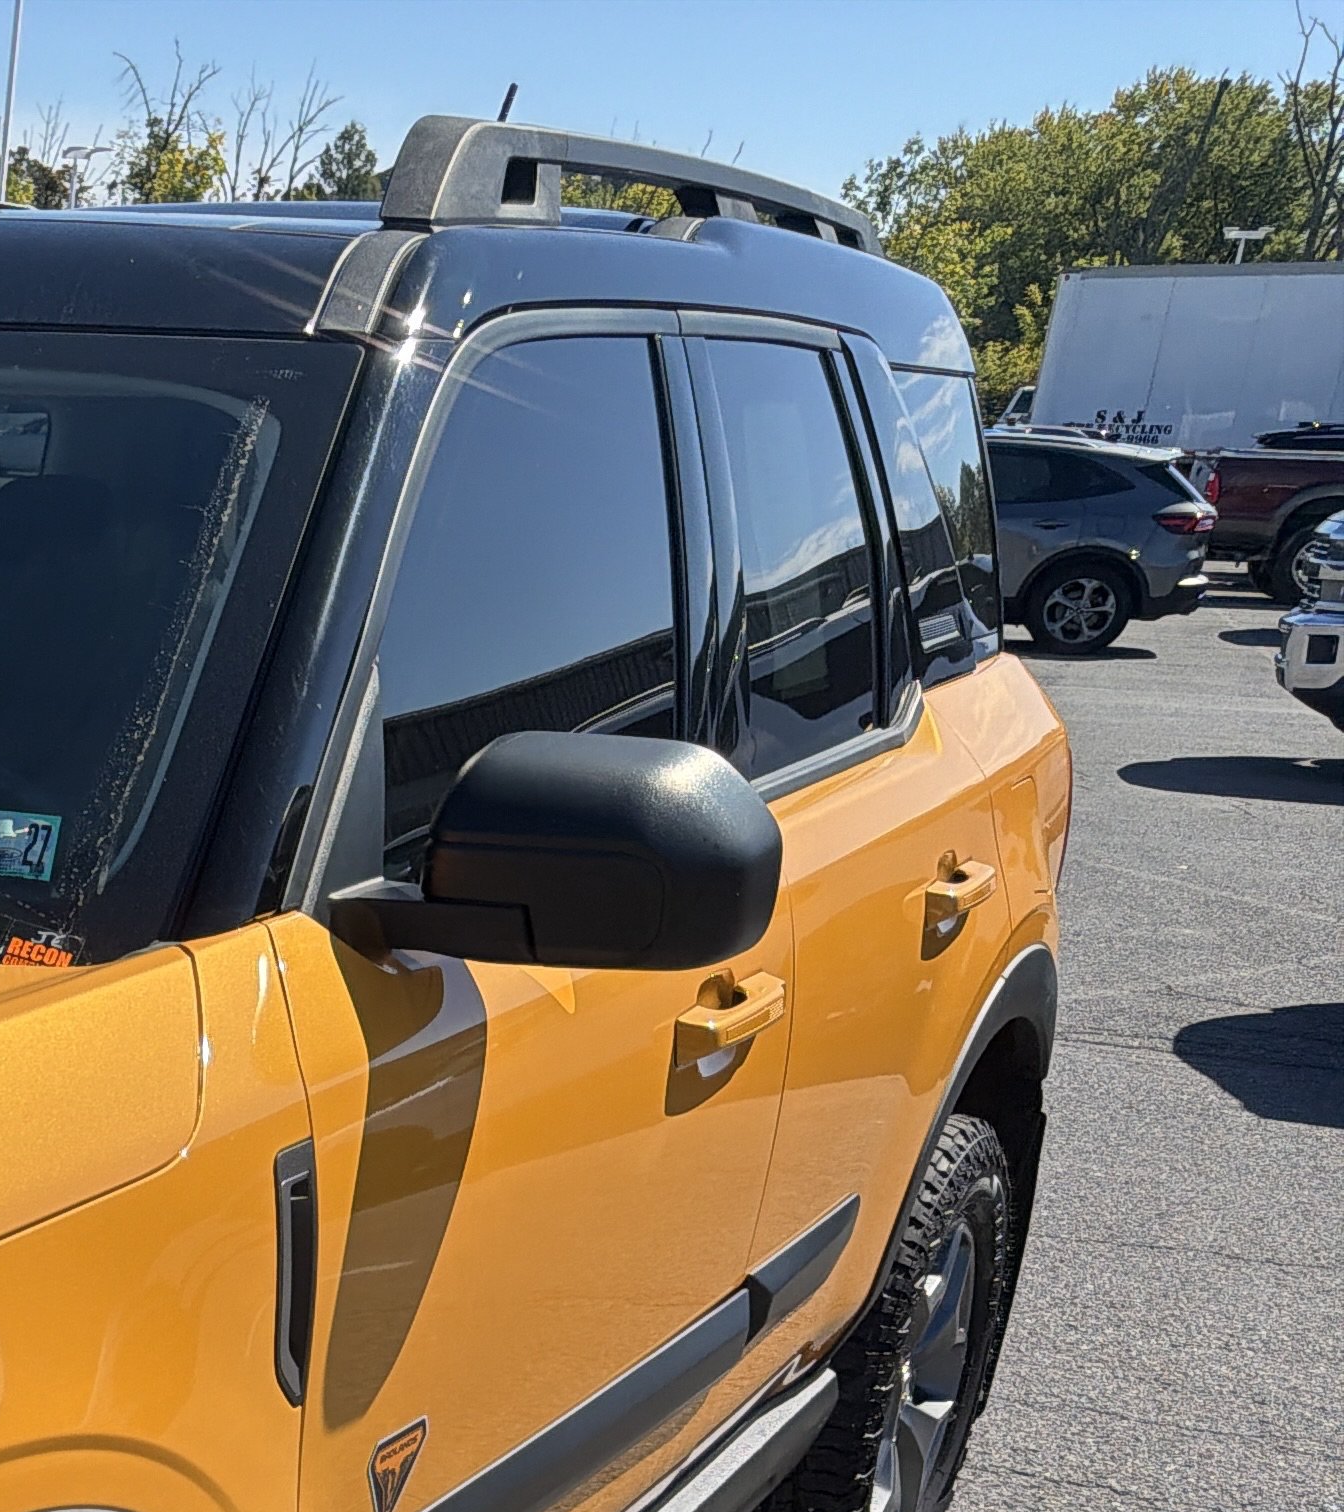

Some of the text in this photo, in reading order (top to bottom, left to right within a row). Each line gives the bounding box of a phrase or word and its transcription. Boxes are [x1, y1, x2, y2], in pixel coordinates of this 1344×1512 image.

[1095, 410, 1145, 424] S & J
[22, 823, 53, 867] 27
[7, 936, 73, 968] RECON
